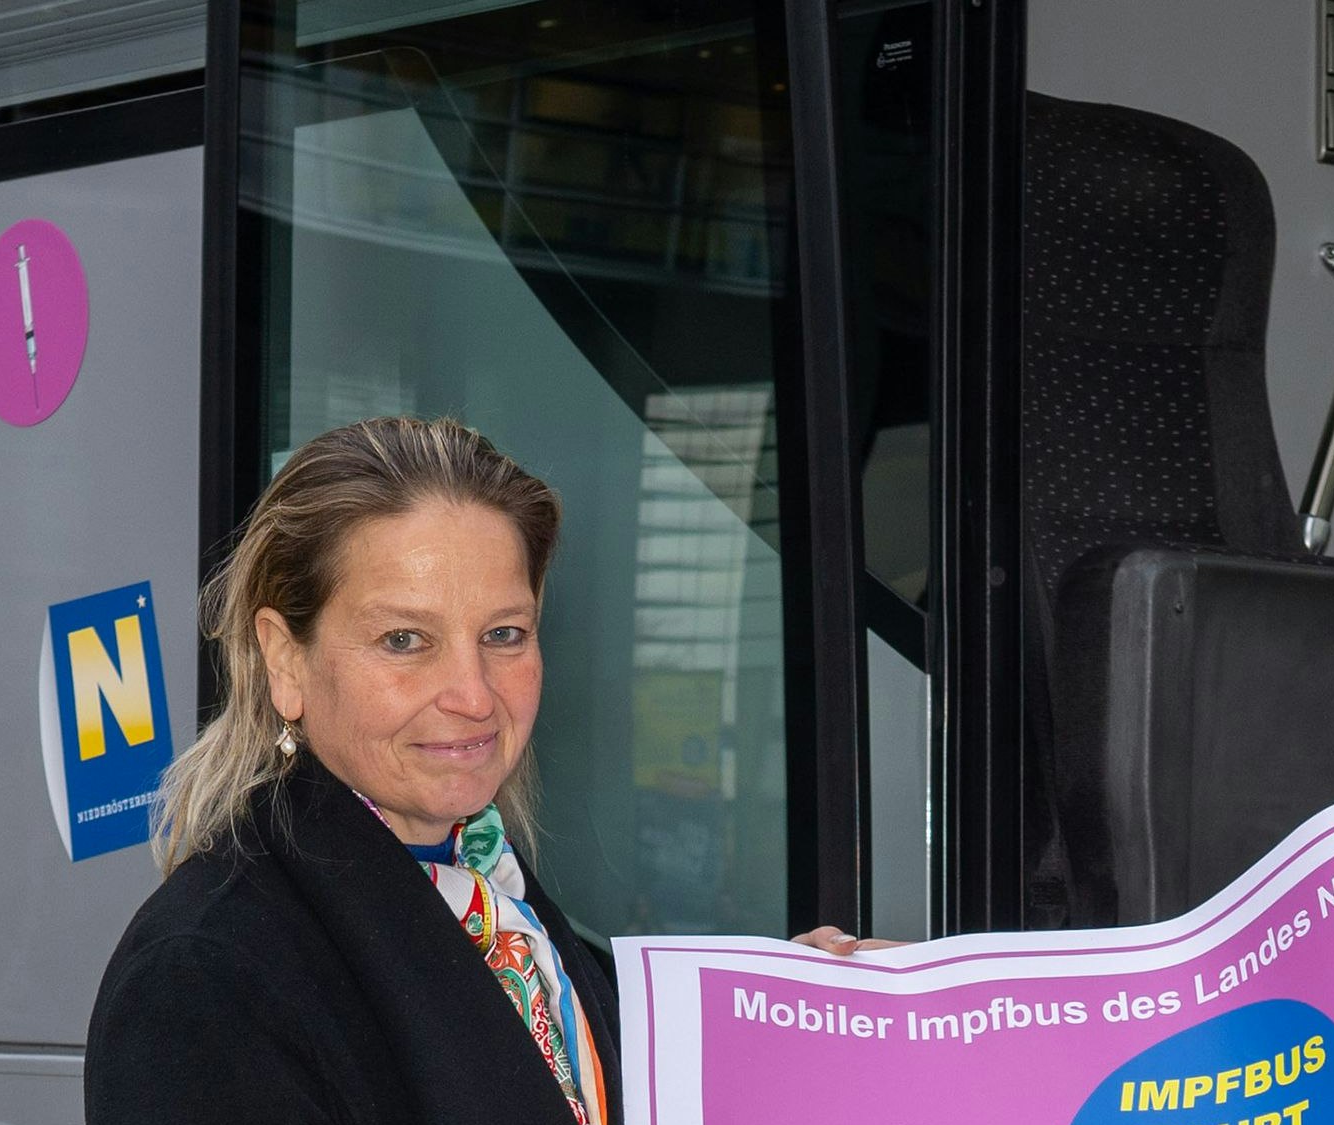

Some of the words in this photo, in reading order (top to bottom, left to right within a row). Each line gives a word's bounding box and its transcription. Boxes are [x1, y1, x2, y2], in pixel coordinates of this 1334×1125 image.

[77, 790, 157, 824] NIEDERÖSTERRE
[733, 987, 893, 1039] Mobiler
[908, 995, 1087, 1044] Impfbus
[1103, 987, 1181, 1024] des
[1194, 908, 1311, 1005] Landes
[1120, 1035, 1326, 1112] IMPFBUS
